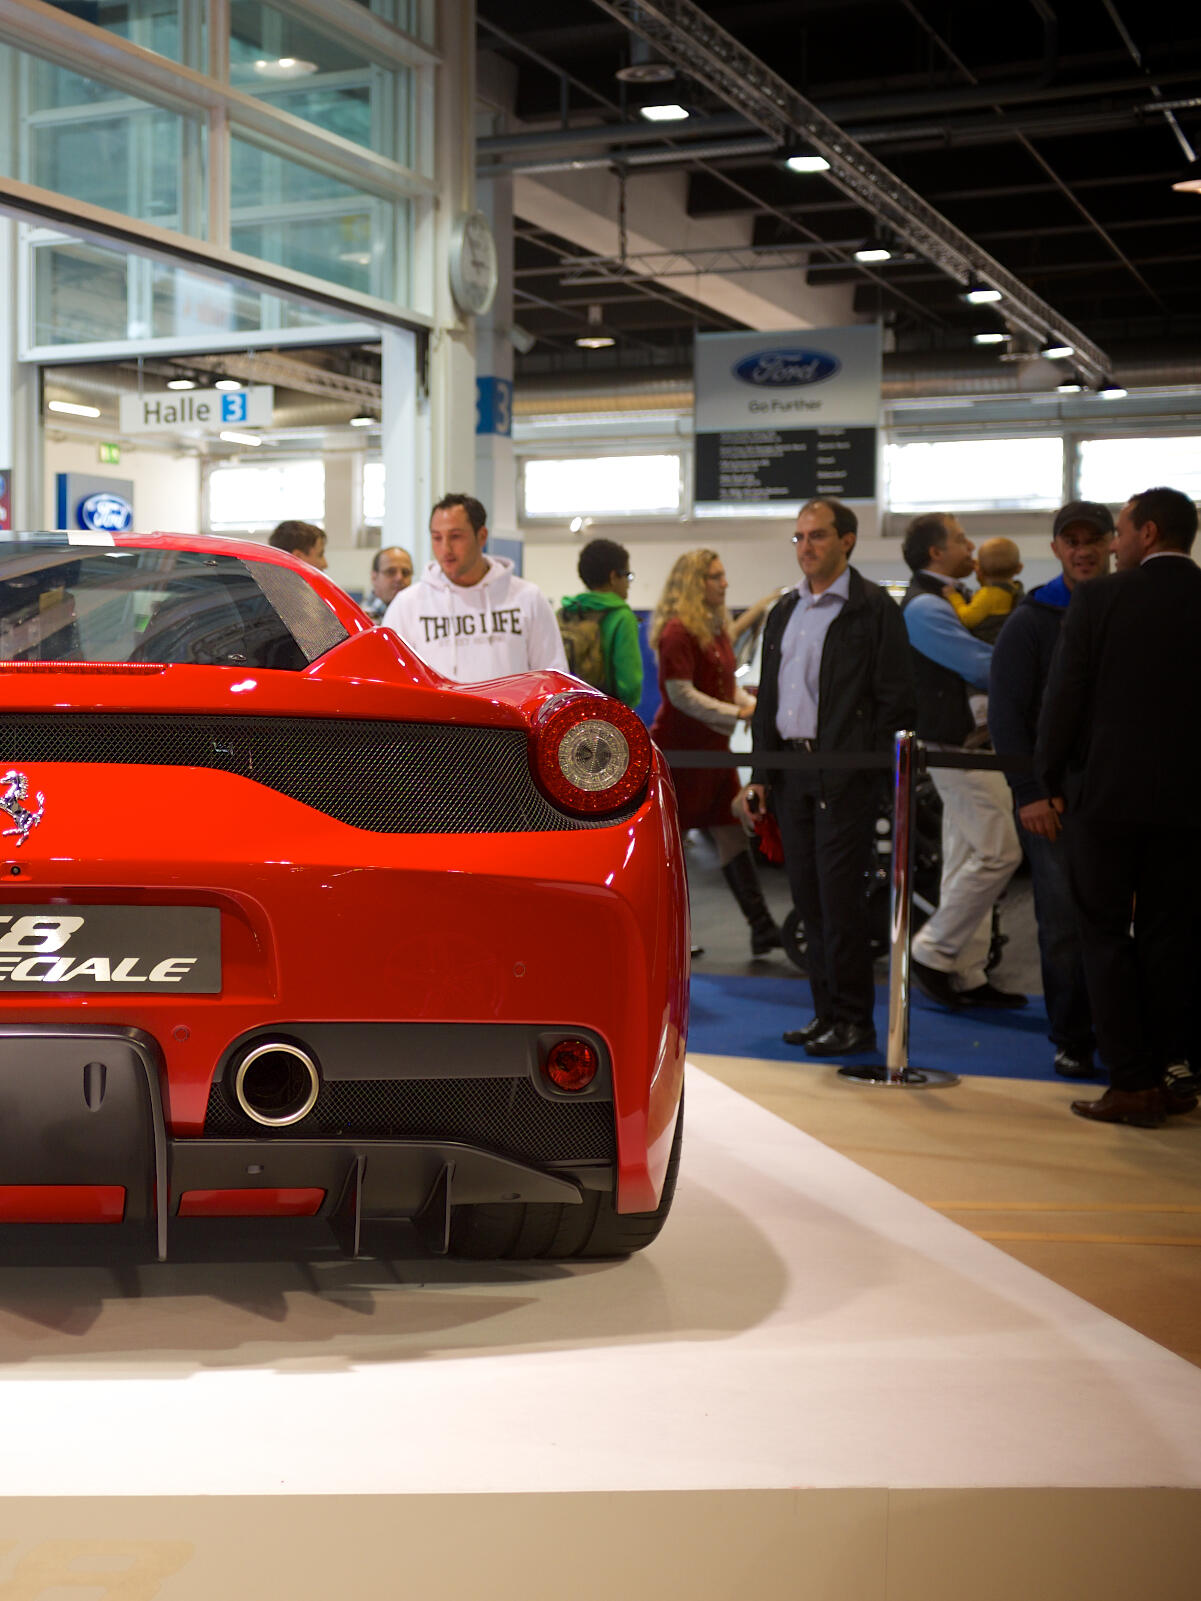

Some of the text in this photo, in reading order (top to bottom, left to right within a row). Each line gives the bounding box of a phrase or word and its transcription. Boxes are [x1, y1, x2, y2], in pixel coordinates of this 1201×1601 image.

[752, 353, 820, 383] Ford
[143, 395, 243, 425] Halle 3
[496, 382, 510, 433] 3
[771, 399, 822, 413] Further
